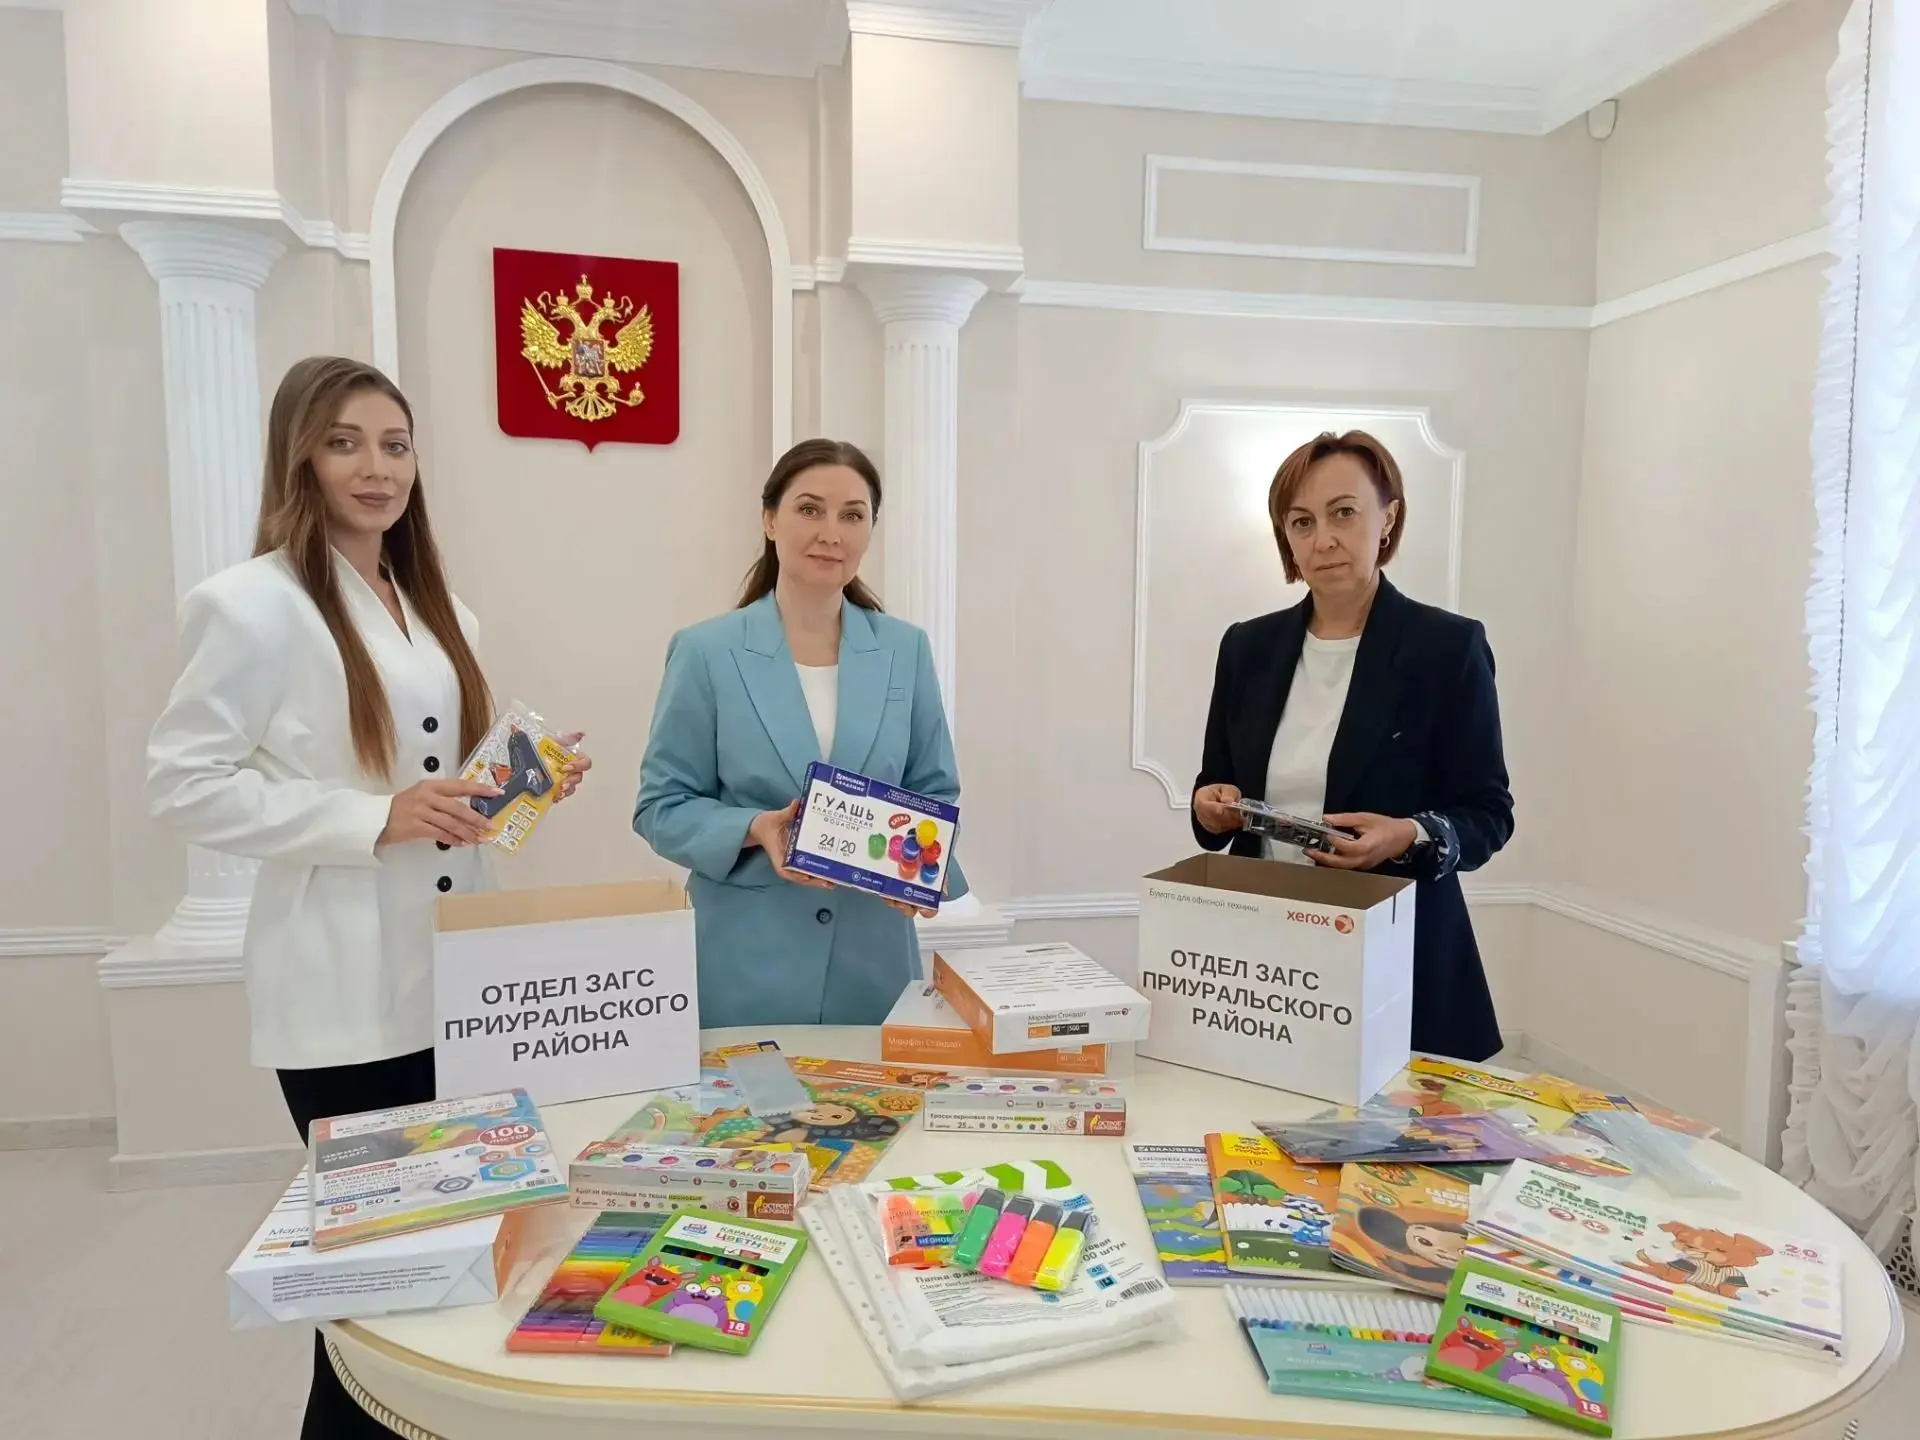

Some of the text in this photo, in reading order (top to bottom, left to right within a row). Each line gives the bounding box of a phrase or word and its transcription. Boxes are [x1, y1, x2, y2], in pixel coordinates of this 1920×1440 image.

[814, 792, 875, 821] ГУАШЬ
[819, 833, 856, 855] 24 20
[1287, 909, 1330, 927] xerox
[1170, 949, 1320, 991] ОТДЕЛ ЗАГС
[480, 967, 655, 1006] ОТДЕЛ ЗАГС
[1142, 970, 1353, 1026] ПРИУРАЛЬСКОГО
[445, 993, 689, 1041] ПРИУРАЛЬСКОГО
[1192, 1007, 1293, 1044] РАЙОНА
[512, 1028, 630, 1062] РАЙОНА
[485, 1124, 530, 1140] 100
[575, 1197, 581, 1205] 6
[606, 1198, 617, 1207] 25
[1525, 1179, 1648, 1224] АЛЬБОМ
[713, 1232, 784, 1254] ЦВЕТНЫЕ
[719, 1226, 788, 1247] КАРАНДАШИ
[1784, 1243, 1819, 1258] 20
[729, 1321, 746, 1331] 18
[1580, 1399, 1603, 1414] 18
